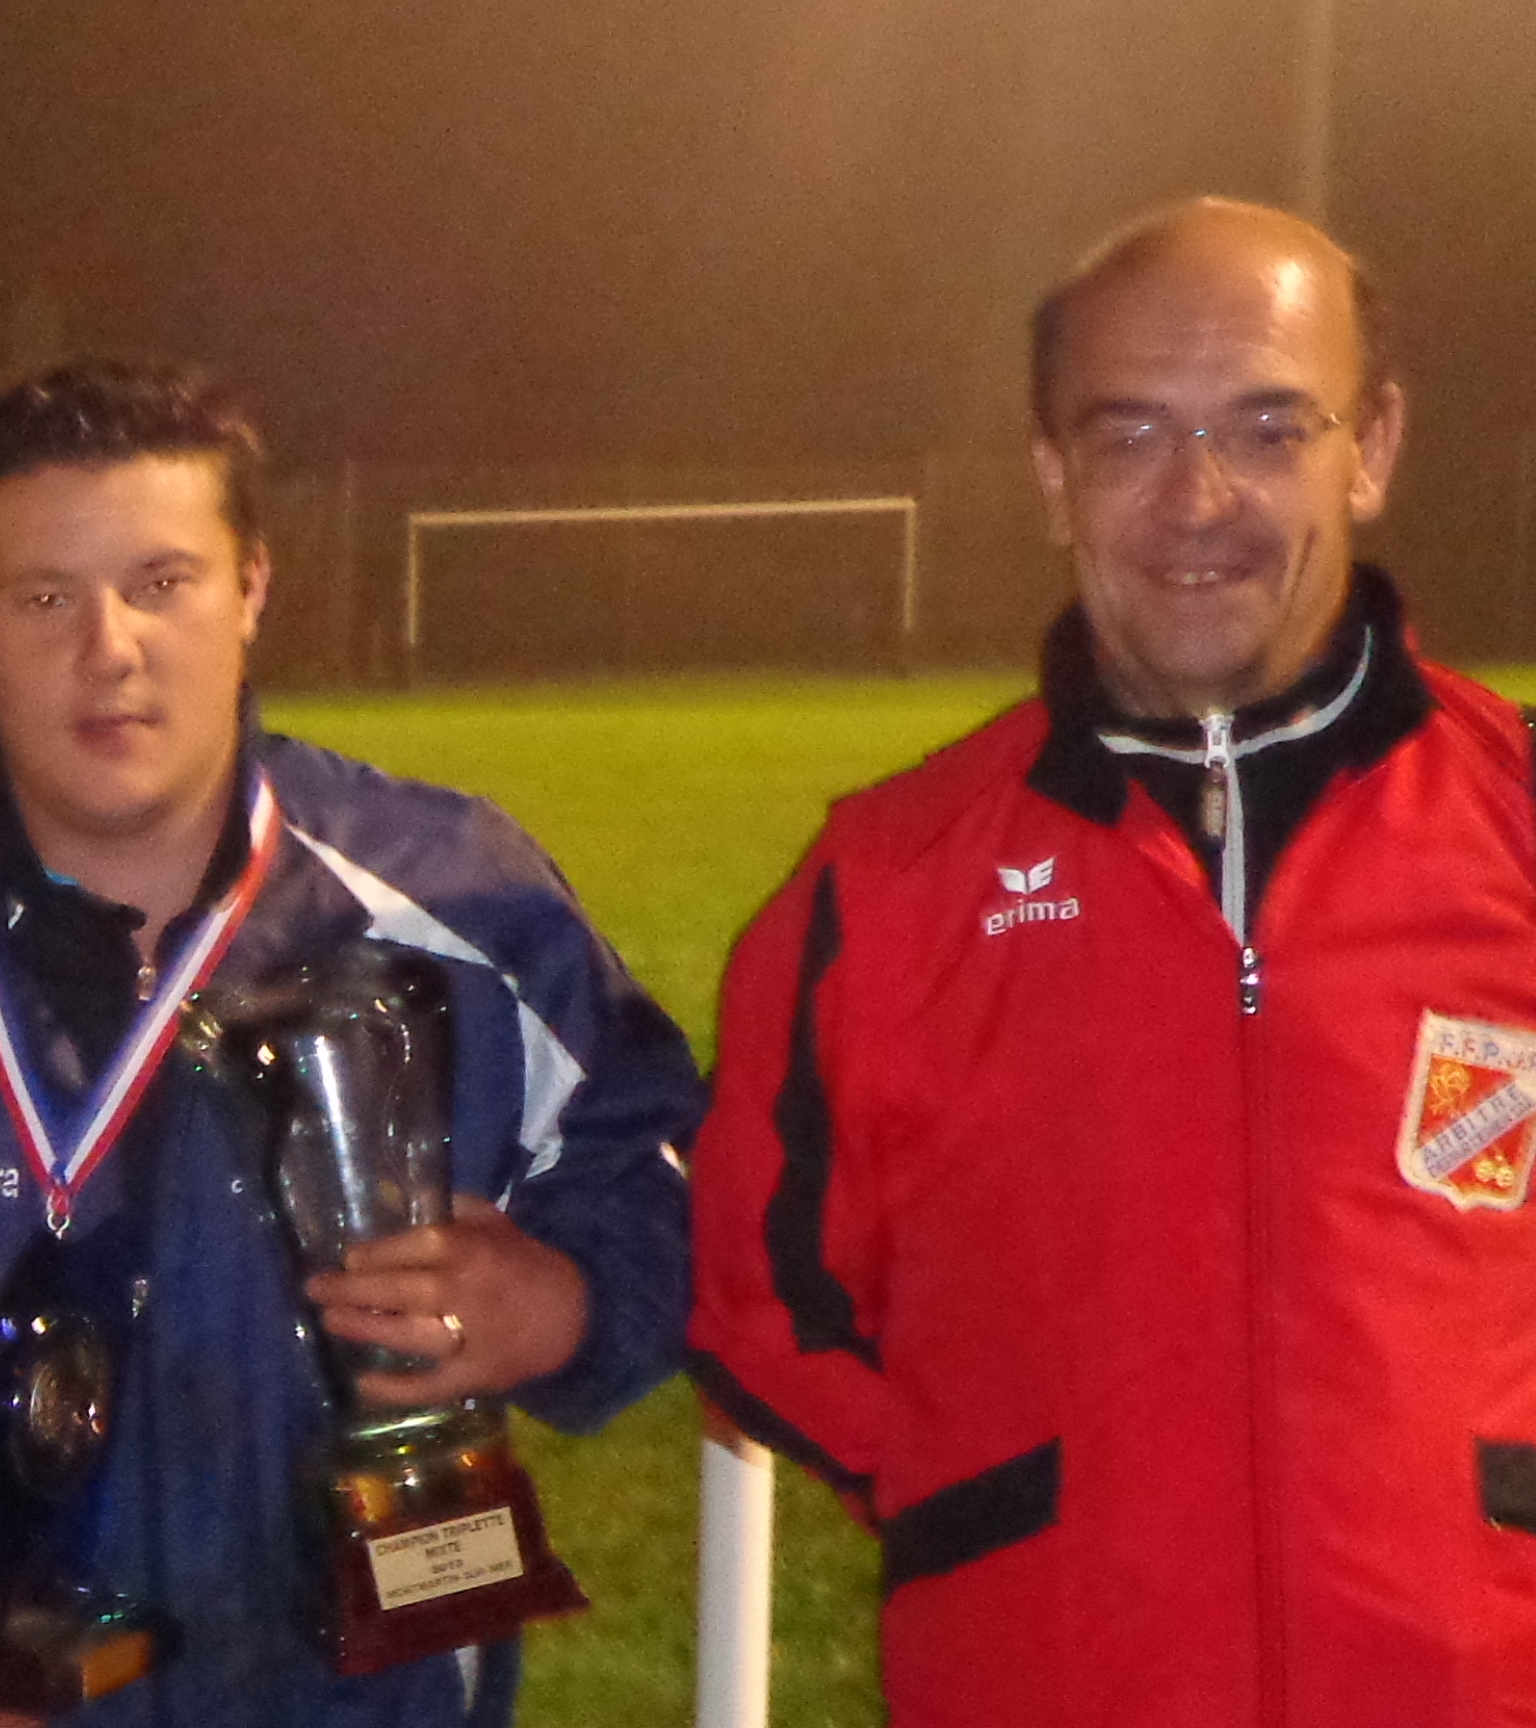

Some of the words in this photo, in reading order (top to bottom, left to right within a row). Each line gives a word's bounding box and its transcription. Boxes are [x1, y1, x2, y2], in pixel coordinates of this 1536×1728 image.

[986, 897, 1080, 935] erima
[1425, 1081, 1522, 1162] ARBITRE
[442, 1514, 505, 1538] TRIPLETTE
